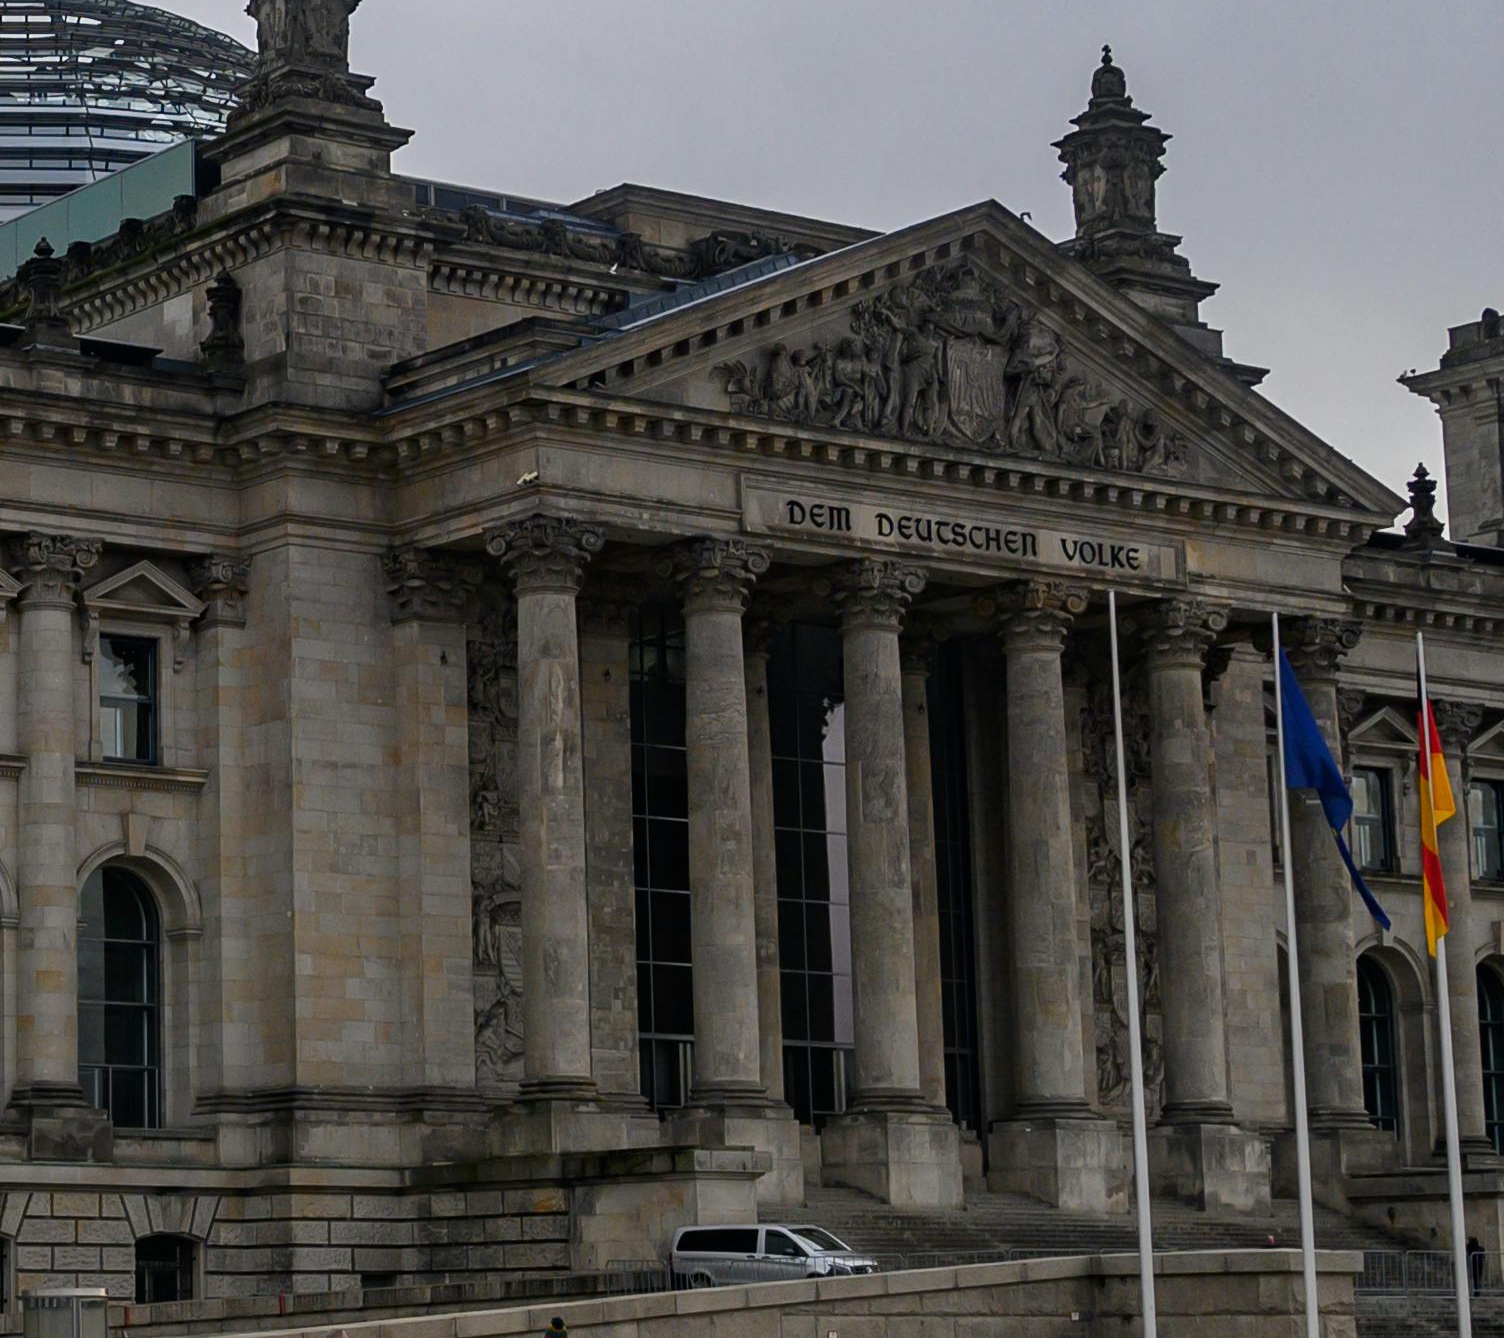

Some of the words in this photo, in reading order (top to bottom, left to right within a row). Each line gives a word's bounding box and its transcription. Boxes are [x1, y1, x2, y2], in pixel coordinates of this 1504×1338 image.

[786, 500, 851, 532] DEM
[875, 513, 1038, 557] DEUTSCHEN
[1060, 538, 1139, 570] VOLKE
